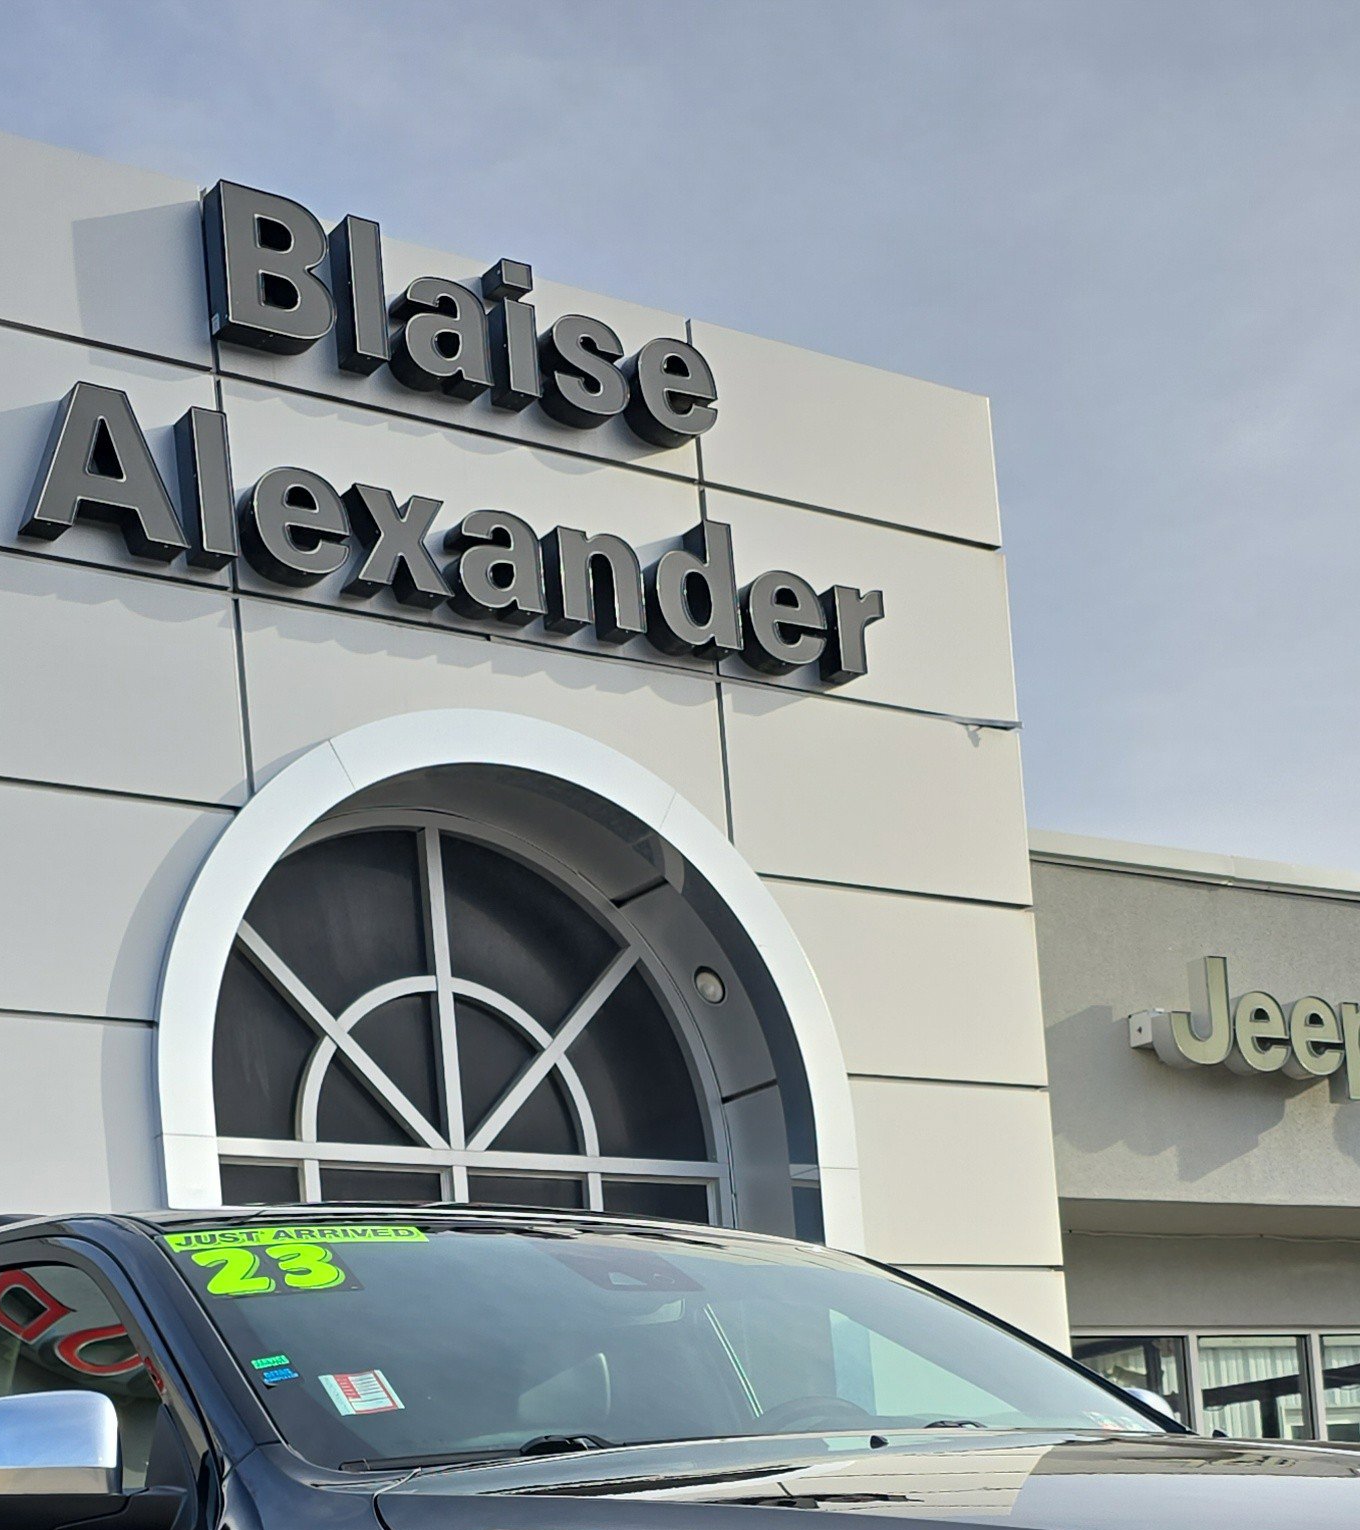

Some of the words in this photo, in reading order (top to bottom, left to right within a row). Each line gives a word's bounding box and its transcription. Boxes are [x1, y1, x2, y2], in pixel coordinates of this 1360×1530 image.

[203, 179, 718, 448] Blaise
[19, 380, 883, 684] Alexander
[175, 1231, 261, 1248] JUST
[272, 1227, 417, 1241] ARRIVED
[191, 1243, 346, 1296] 23
